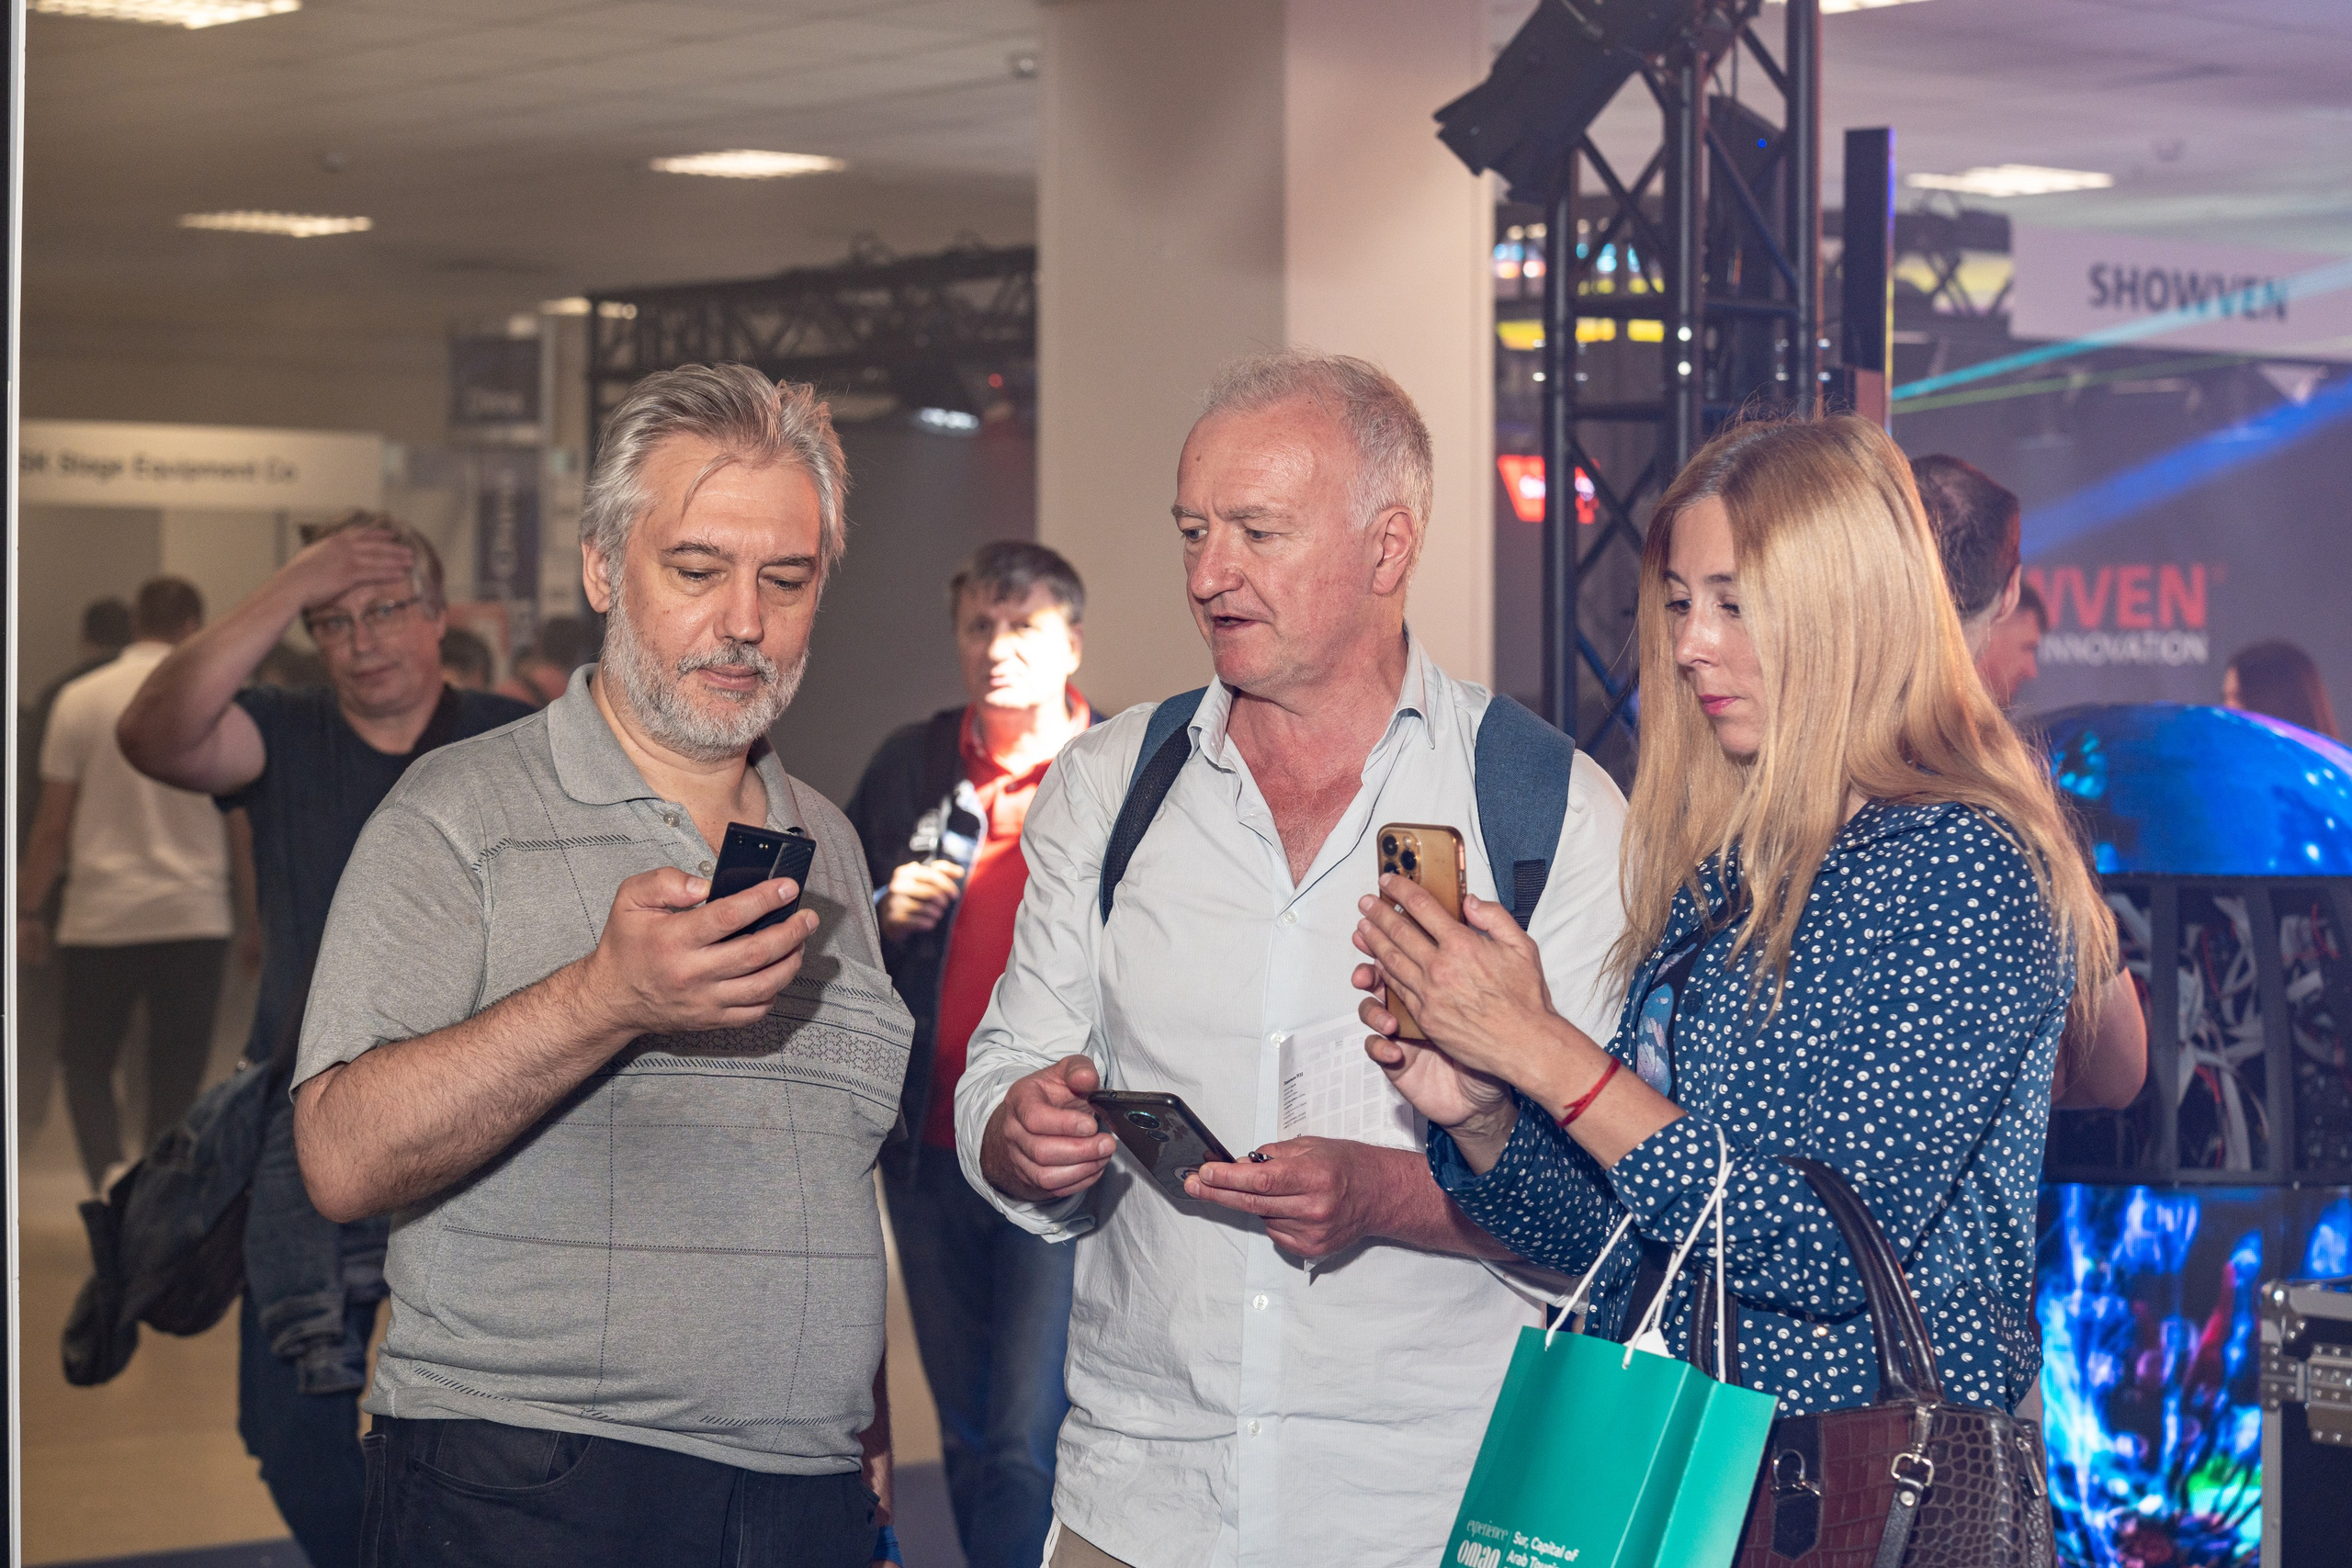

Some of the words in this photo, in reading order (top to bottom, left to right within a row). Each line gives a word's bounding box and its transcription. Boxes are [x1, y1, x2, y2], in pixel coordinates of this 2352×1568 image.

[2088, 262, 2287, 319] SHOWVEN
[2037, 631, 2209, 665] NNOVATION
[1506, 1550, 1529, 1567] Arab
[1512, 1530, 1530, 1550] Sur,
[1530, 1536, 1566, 1559] Capital
[1564, 1549, 1579, 1562] of
